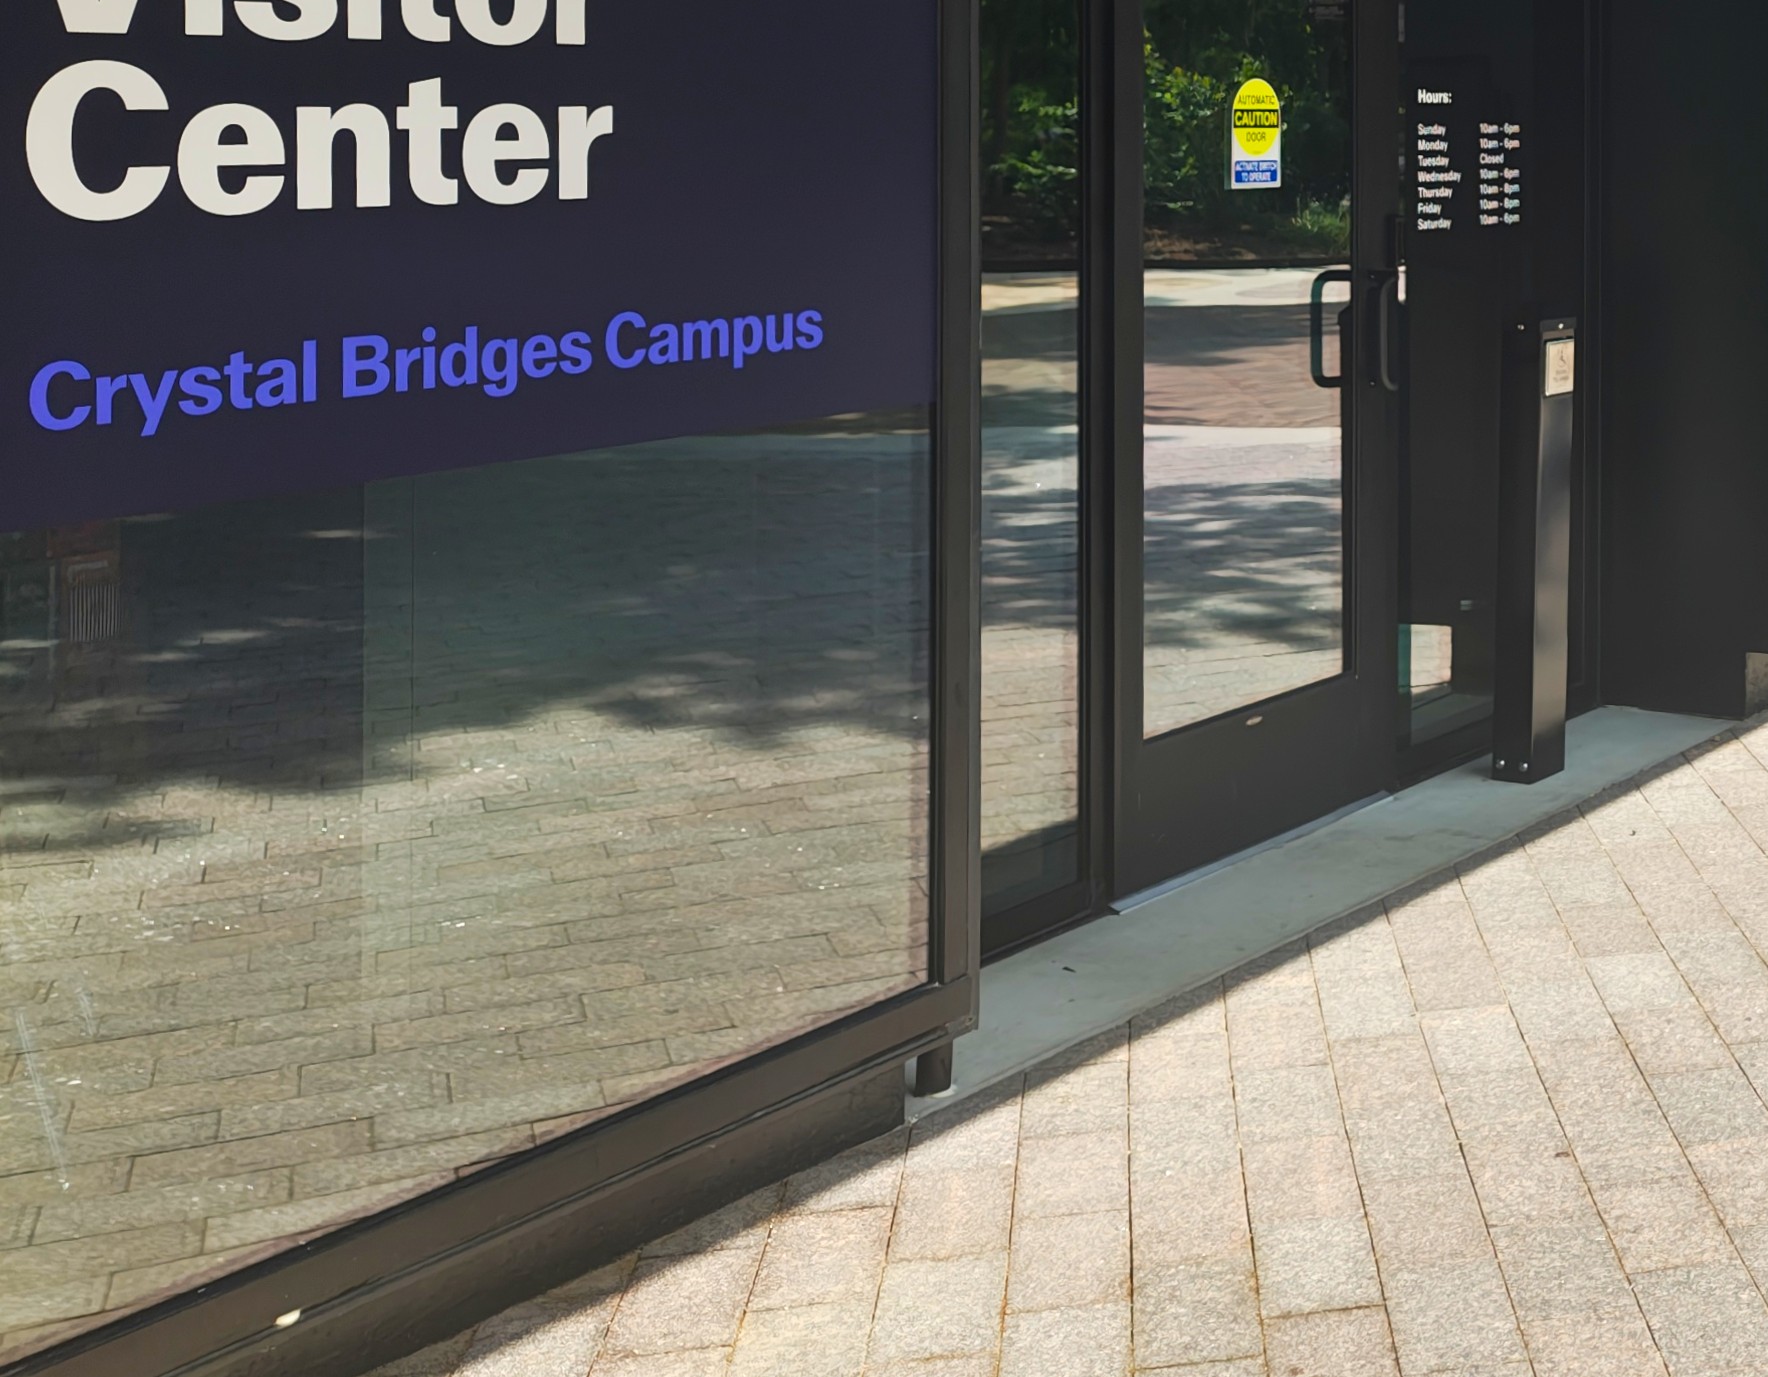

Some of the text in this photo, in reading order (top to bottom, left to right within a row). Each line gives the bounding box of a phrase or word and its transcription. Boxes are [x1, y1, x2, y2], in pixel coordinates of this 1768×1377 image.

[1238, 95, 1275, 105] AUTOMATIC
[1418, 89, 1451, 103] Hours:
[1235, 111, 1278, 126] CAUTION
[1418, 124, 1446, 136] Sunday
[1480, 123, 1498, 133] 10am
[26, 60, 613, 221] Center
[1246, 132, 1266, 142] DOOR
[1418, 139, 1448, 152] Monday
[1480, 138, 1498, 149] 10am
[1418, 153, 1504, 167] Tuesday Closed
[1418, 170, 1461, 182] Wednesday
[1480, 169, 1498, 179] 10am
[1418, 186, 1452, 198] Thursday
[1480, 184, 1498, 194] 10am
[1418, 203, 1441, 214] Friday
[1480, 199, 1498, 209] 10am
[1418, 218, 1451, 230] Saturday
[1480, 214, 1498, 225] 10am
[29, 310, 823, 436] Crystal Bridges Campus
